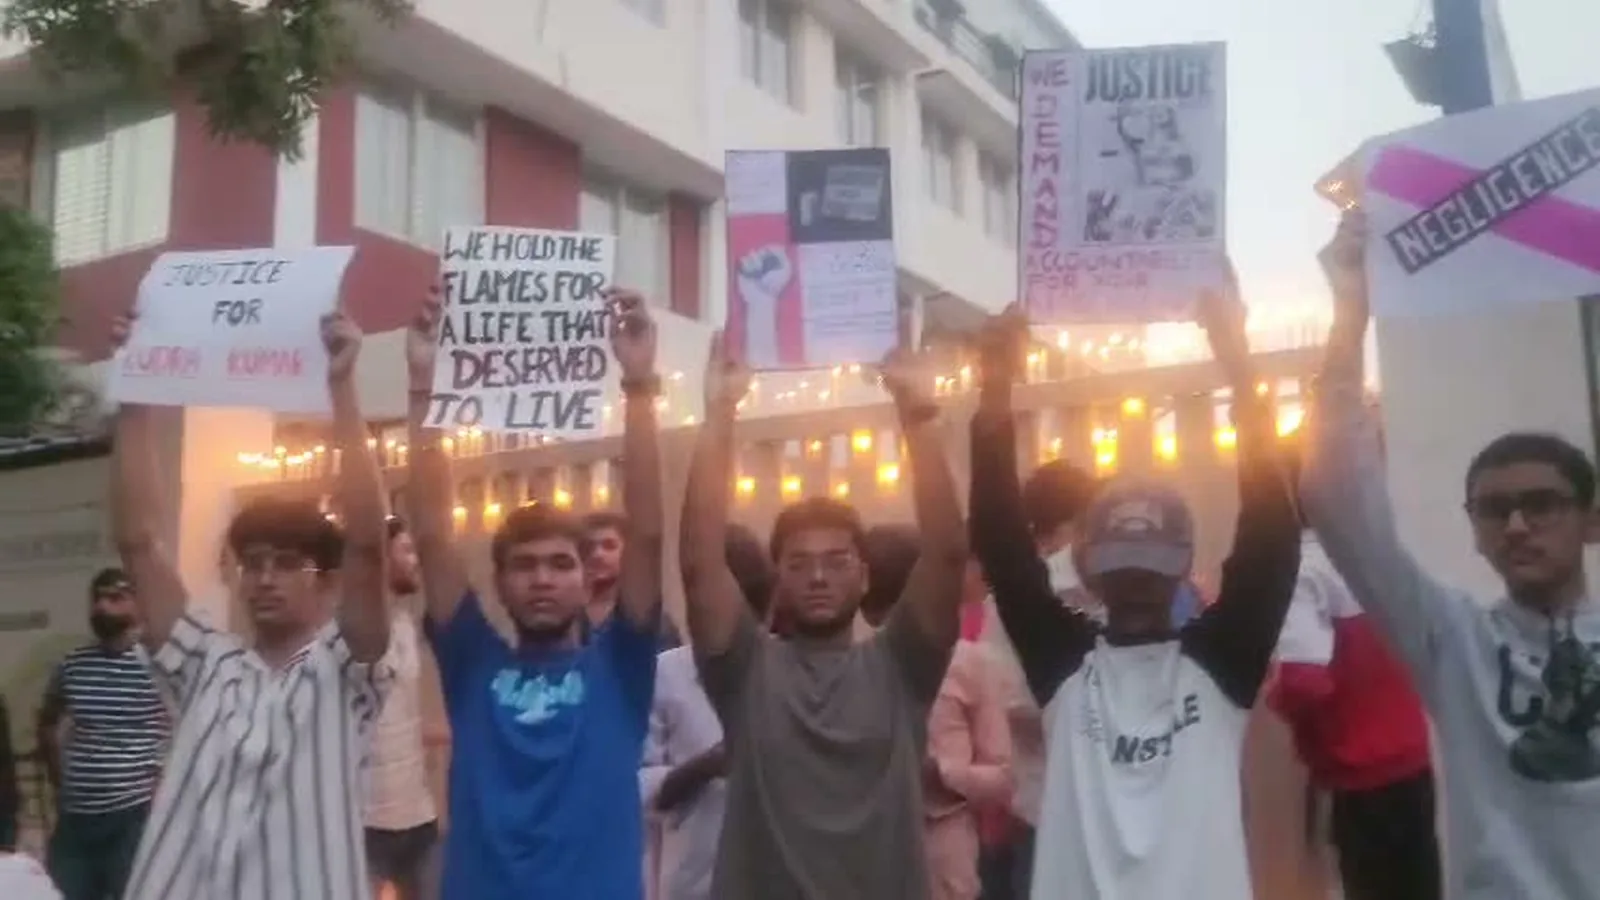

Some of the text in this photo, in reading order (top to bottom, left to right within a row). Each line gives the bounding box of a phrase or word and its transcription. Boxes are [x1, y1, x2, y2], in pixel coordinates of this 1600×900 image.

[1084, 53, 1215, 102] JUSTICE
[1394, 115, 1600, 267] NEGLIGENCE
[444, 231, 604, 262] WE HOLD THE
[163, 260, 293, 286] JUSTICE
[443, 269, 608, 305] FLAMES FOR
[212, 299, 263, 326] FOR
[439, 309, 609, 346] A LIFE THAT
[451, 345, 608, 390] DESERVED
[429, 388, 604, 430] TO LIVE
